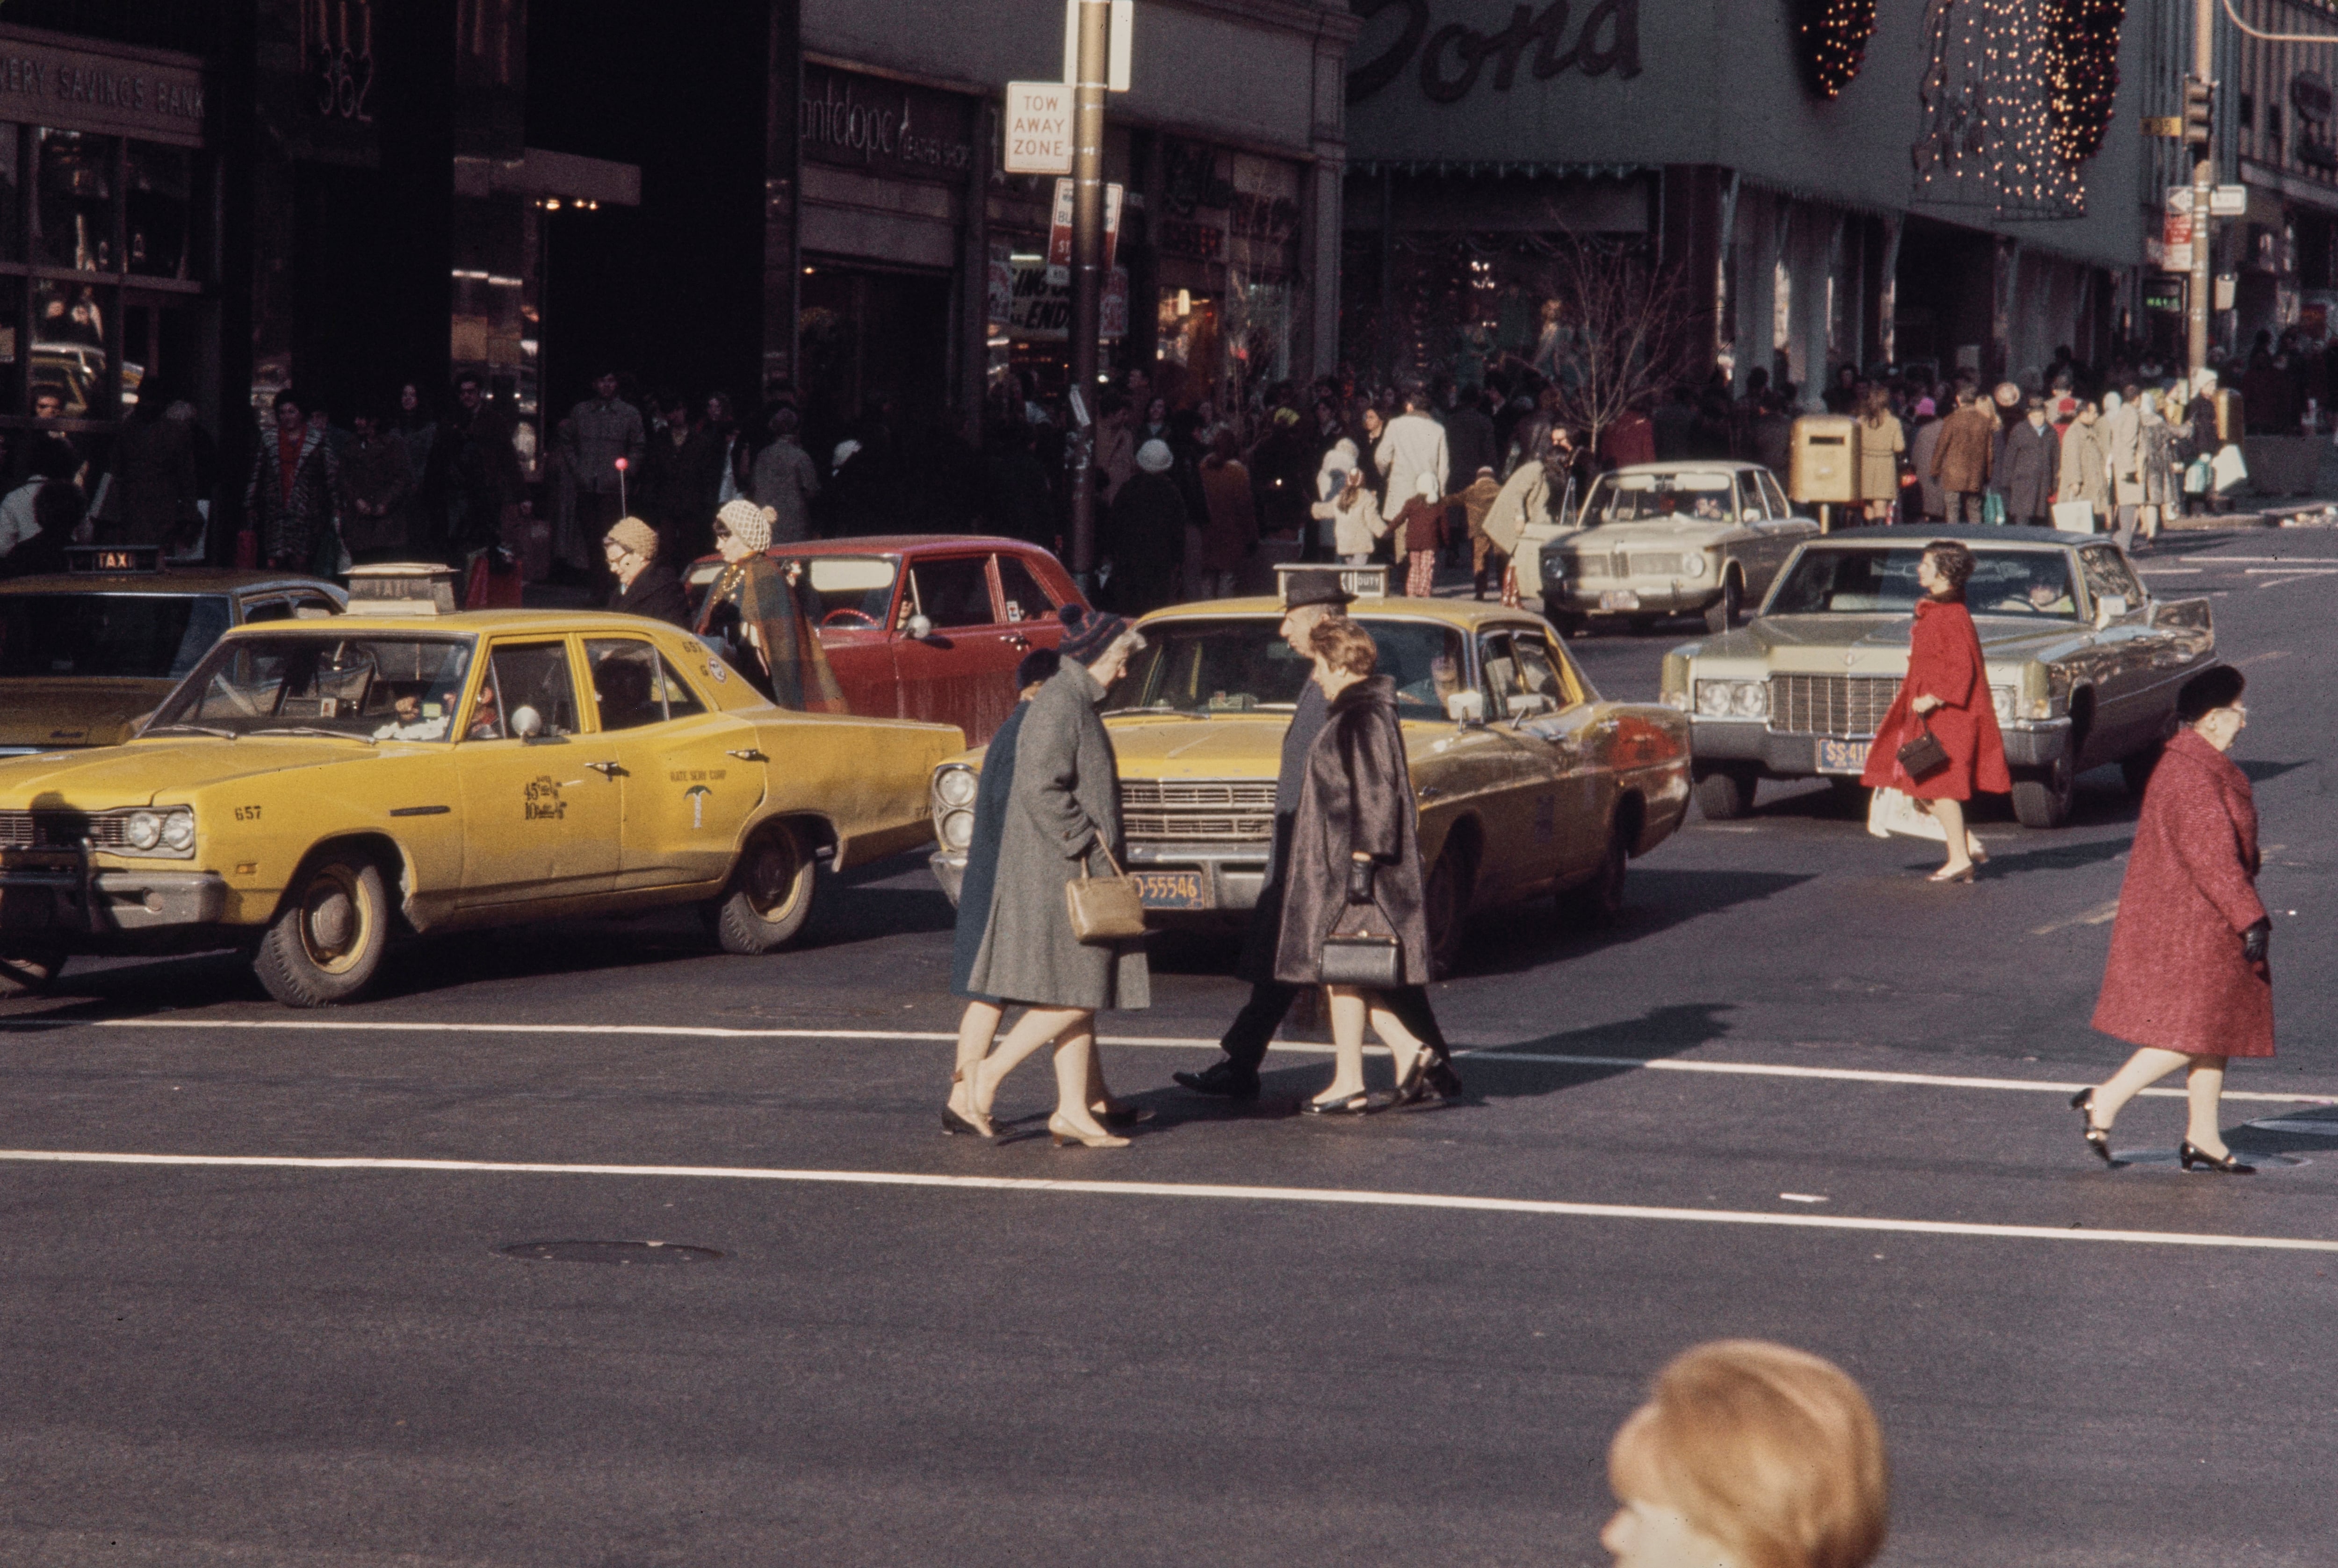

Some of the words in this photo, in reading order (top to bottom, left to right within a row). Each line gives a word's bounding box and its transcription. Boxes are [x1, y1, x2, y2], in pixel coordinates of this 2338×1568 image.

[59, 64, 145, 110] SAVINGS
[157, 80, 206, 118] BANK
[1024, 96, 1059, 111] TOW
[1014, 118, 1065, 133] AWAY
[1013, 139, 1064, 156] ZONE
[97, 552, 135, 568] TAXI
[1357, 575, 1379, 586] DUTY
[234, 805, 261, 821] 657
